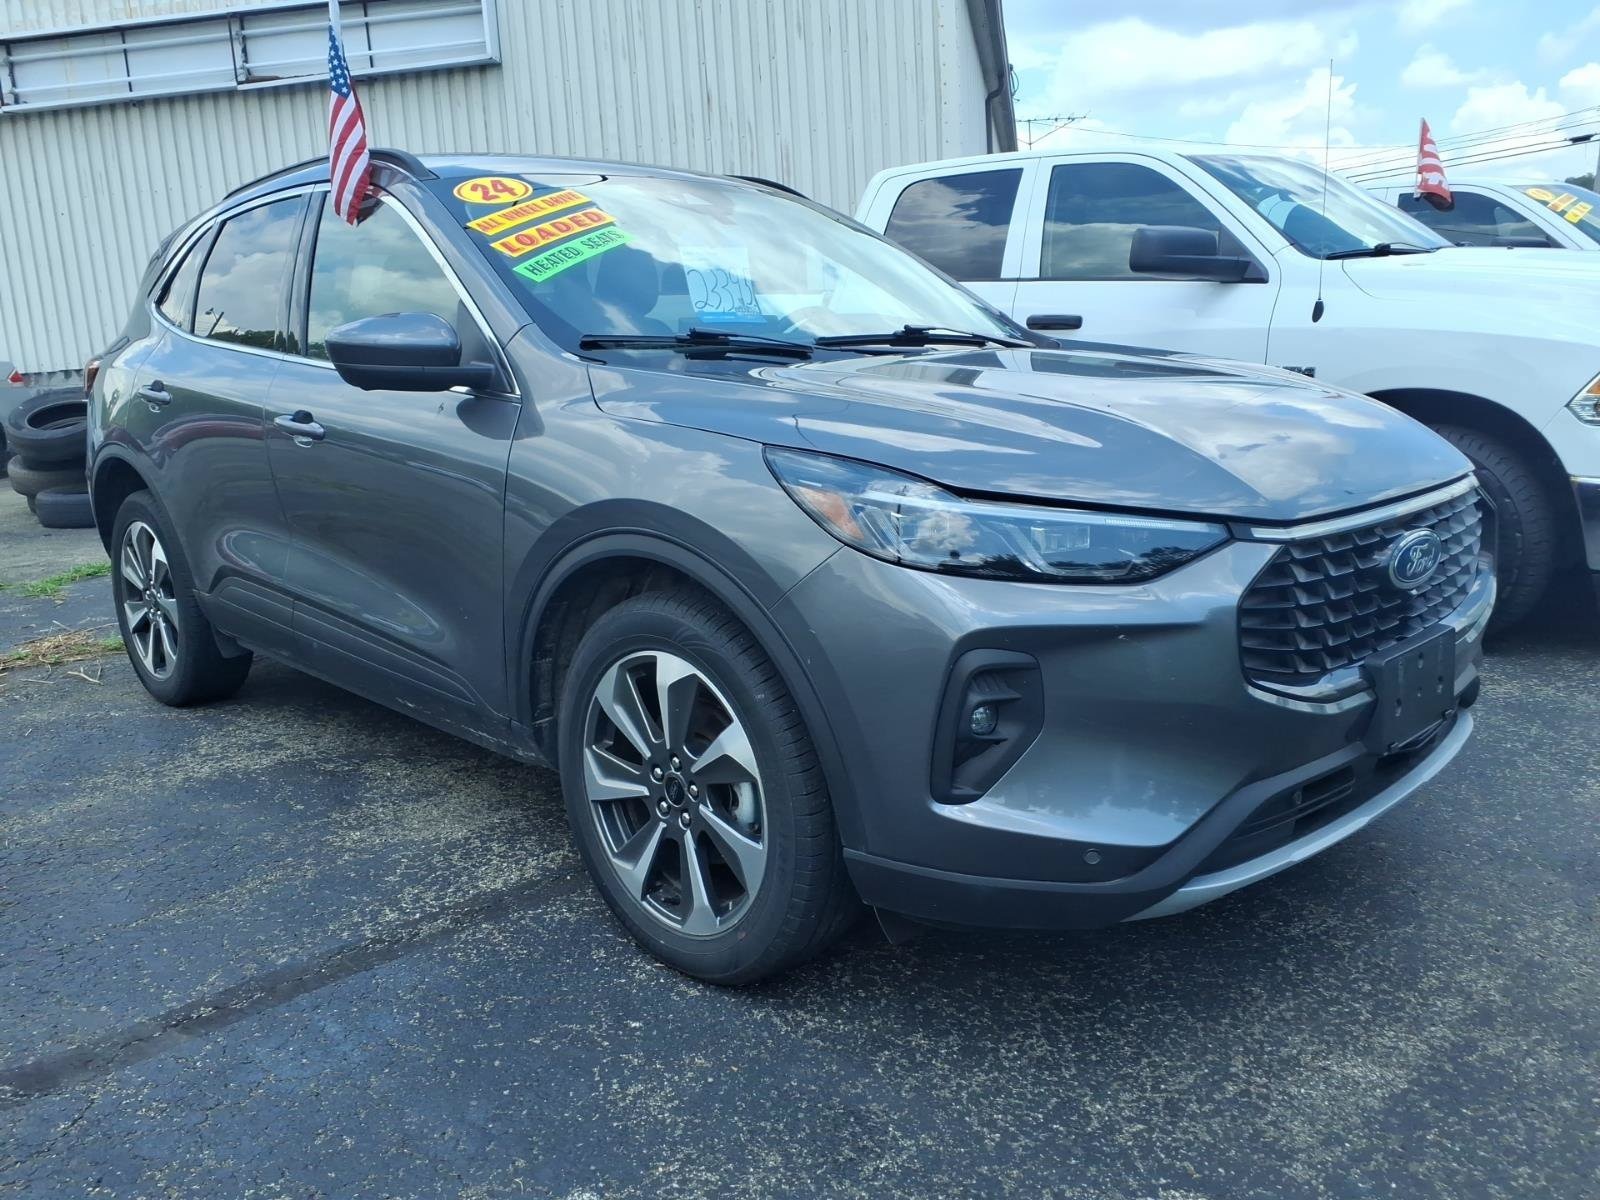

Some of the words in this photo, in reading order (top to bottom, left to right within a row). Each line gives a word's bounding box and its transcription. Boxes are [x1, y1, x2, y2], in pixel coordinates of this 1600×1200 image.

[470, 179, 519, 202] 24
[475, 217, 503, 232] ALL
[501, 203, 544, 221] WHEEL
[542, 191, 583, 208] DRIVE
[499, 210, 607, 253] LOADED
[523, 246, 583, 276] HEATED
[580, 230, 625, 250] SEATS
[1405, 543, 1435, 577] Ford
